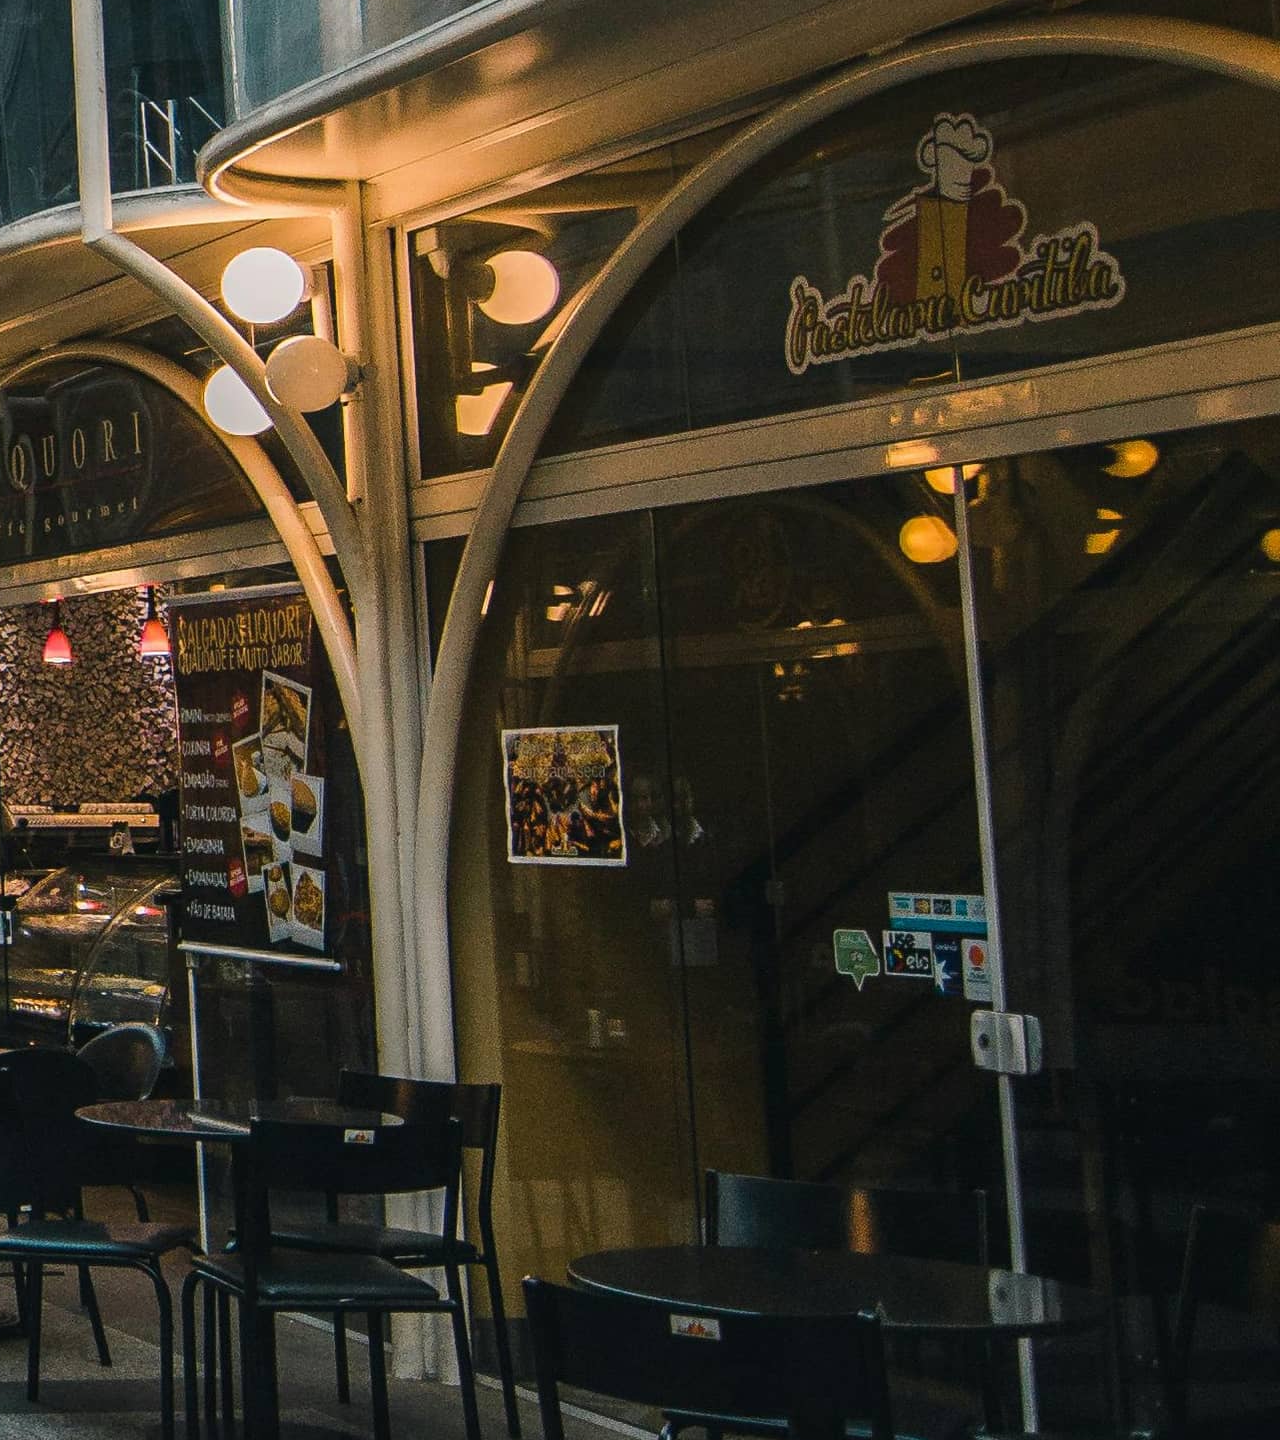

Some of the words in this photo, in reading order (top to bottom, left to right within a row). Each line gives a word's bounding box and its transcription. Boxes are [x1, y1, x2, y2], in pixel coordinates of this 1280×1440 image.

[959, 230, 1117, 326] Curitiba
[44, 496, 138, 533] gourmet
[178, 614, 244, 650] SALGADOS
[178, 648, 227, 675] QUALIDADE
[237, 647, 269, 672] MUITO
[206, 806, 237, 822] COLORIDA
